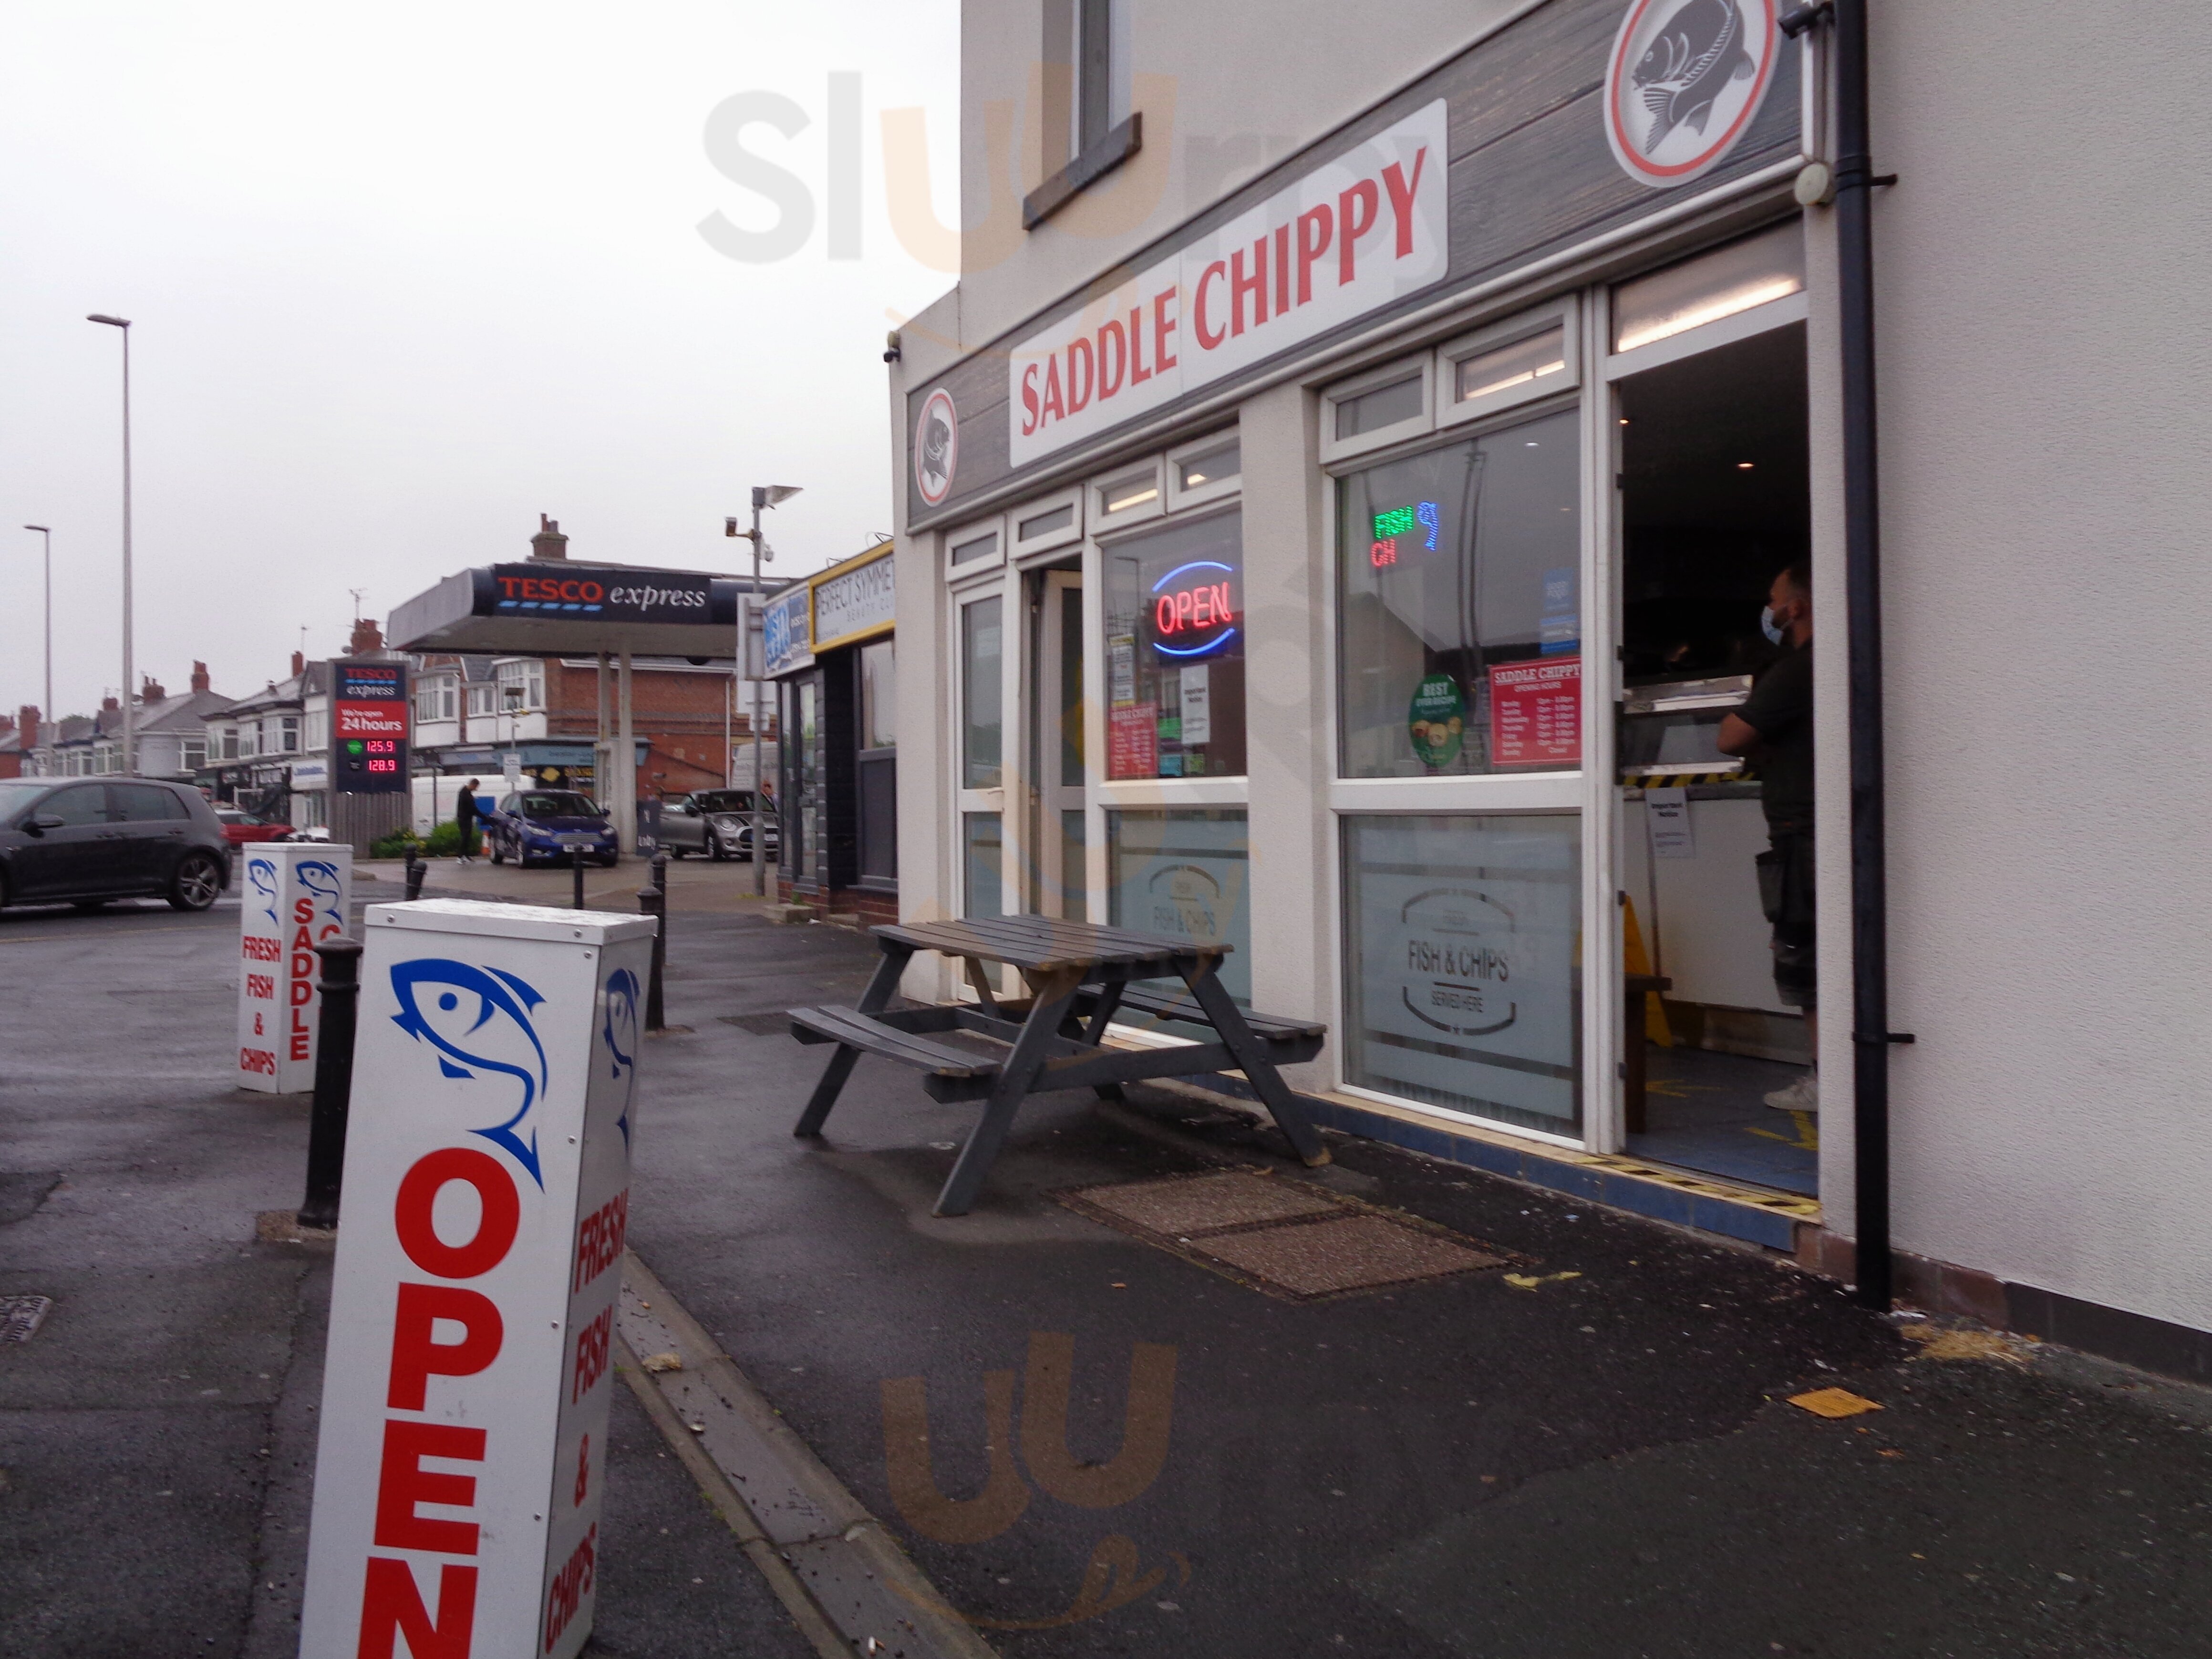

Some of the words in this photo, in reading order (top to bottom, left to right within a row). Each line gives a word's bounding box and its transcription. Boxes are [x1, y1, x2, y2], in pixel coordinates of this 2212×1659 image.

[1022, 285, 1177, 436] SADDLE
[1194, 145, 1427, 351] CHIPPY
[498, 577, 604, 602] TESCO
[610, 585, 706, 611] express
[1157, 581, 1232, 634] OPEN
[345, 669, 397, 679] TESCO
[1494, 669, 1537, 683] SADDLE
[1538, 663, 1581, 679] CHIPPY
[346, 685, 395, 698] express
[1423, 682, 1448, 697] BEST
[341, 717, 360, 730] 24
[361, 717, 403, 731] hours
[367, 741, 393, 752] 125.9
[369, 760, 396, 771] 128.9
[243, 935, 282, 963] FRESH
[1408, 940, 1441, 974] FISH
[1445, 944, 1456, 975] &
[1458, 947, 1509, 982] CHIPS
[247, 973, 274, 1000] FISH
[289, 897, 315, 1061] SADDLE
[254, 1011, 264, 1036] &
[240, 1047, 276, 1076] CHIPS
[575, 1188, 629, 1294] FRESH
[571, 1304, 613, 1405] FISH
[356, 1146, 521, 1659] OPEN
[574, 1432, 589, 1509] &
[545, 1522, 597, 1656] CHIPS
